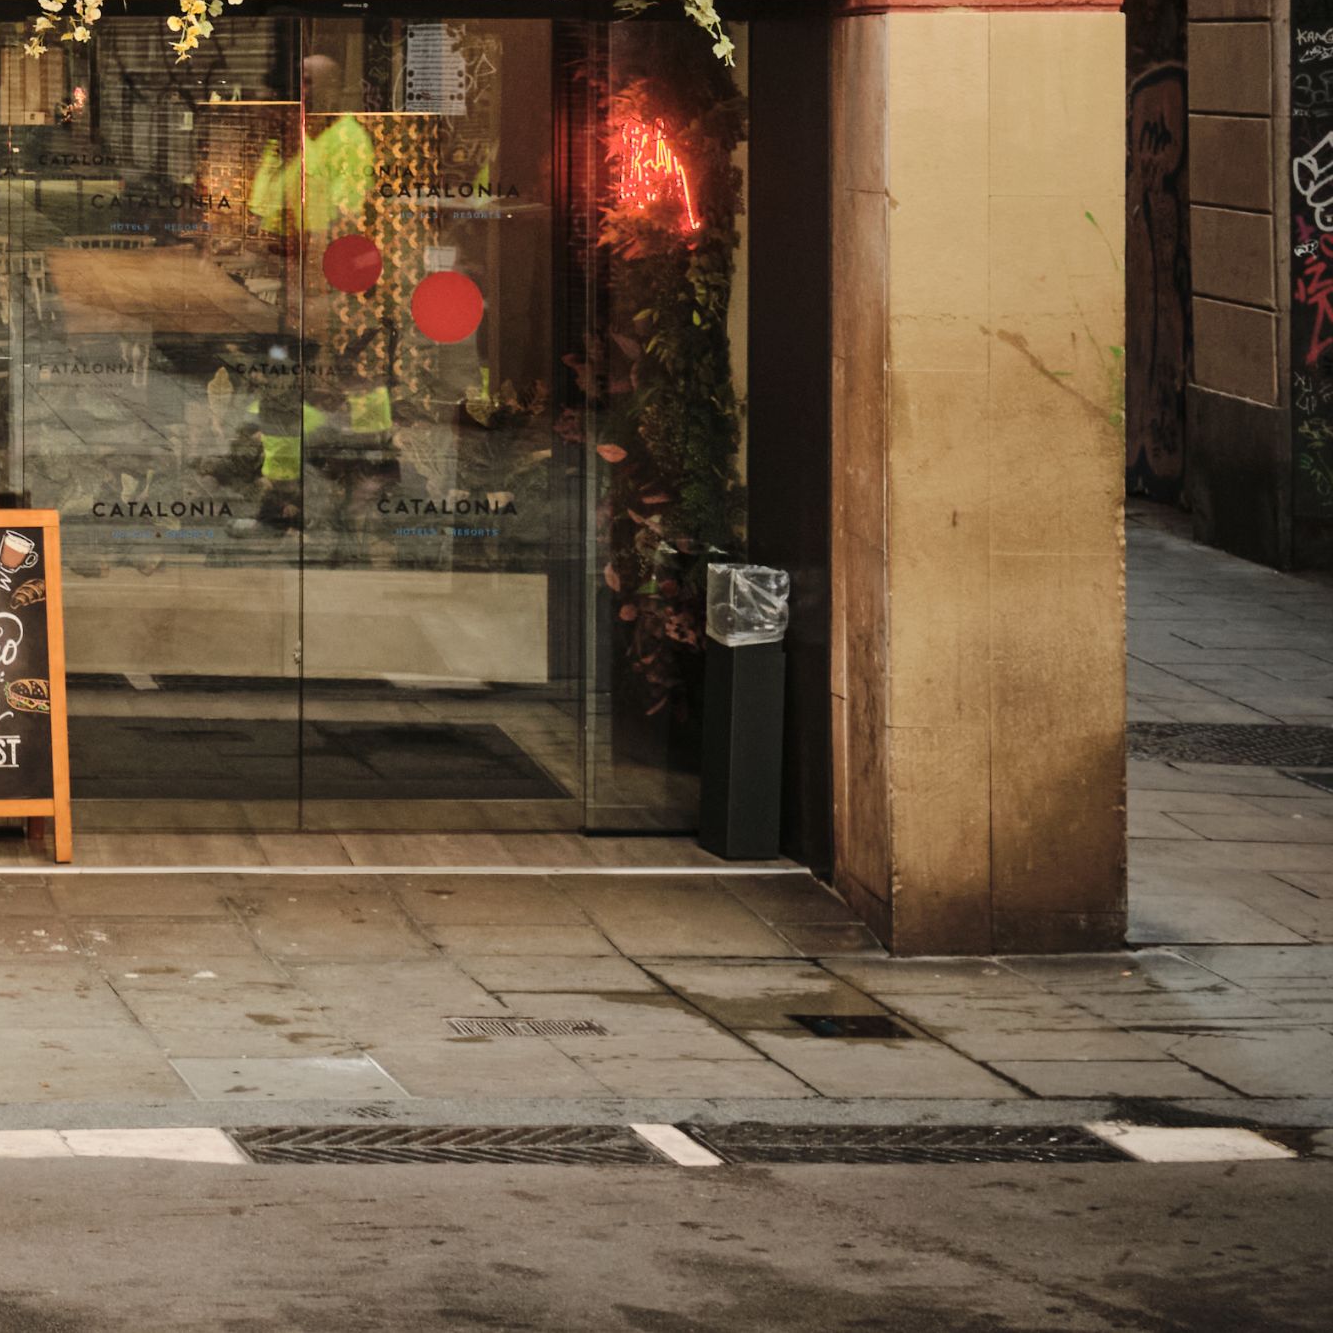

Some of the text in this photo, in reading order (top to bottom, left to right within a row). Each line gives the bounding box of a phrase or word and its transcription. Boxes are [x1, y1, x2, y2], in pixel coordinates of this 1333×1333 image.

[380, 182, 519, 198] CATALONIA
[91, 193, 231, 210] CATALONIA
[92, 501, 233, 516] CATALONIA
[377, 498, 518, 515] CATALONIA
